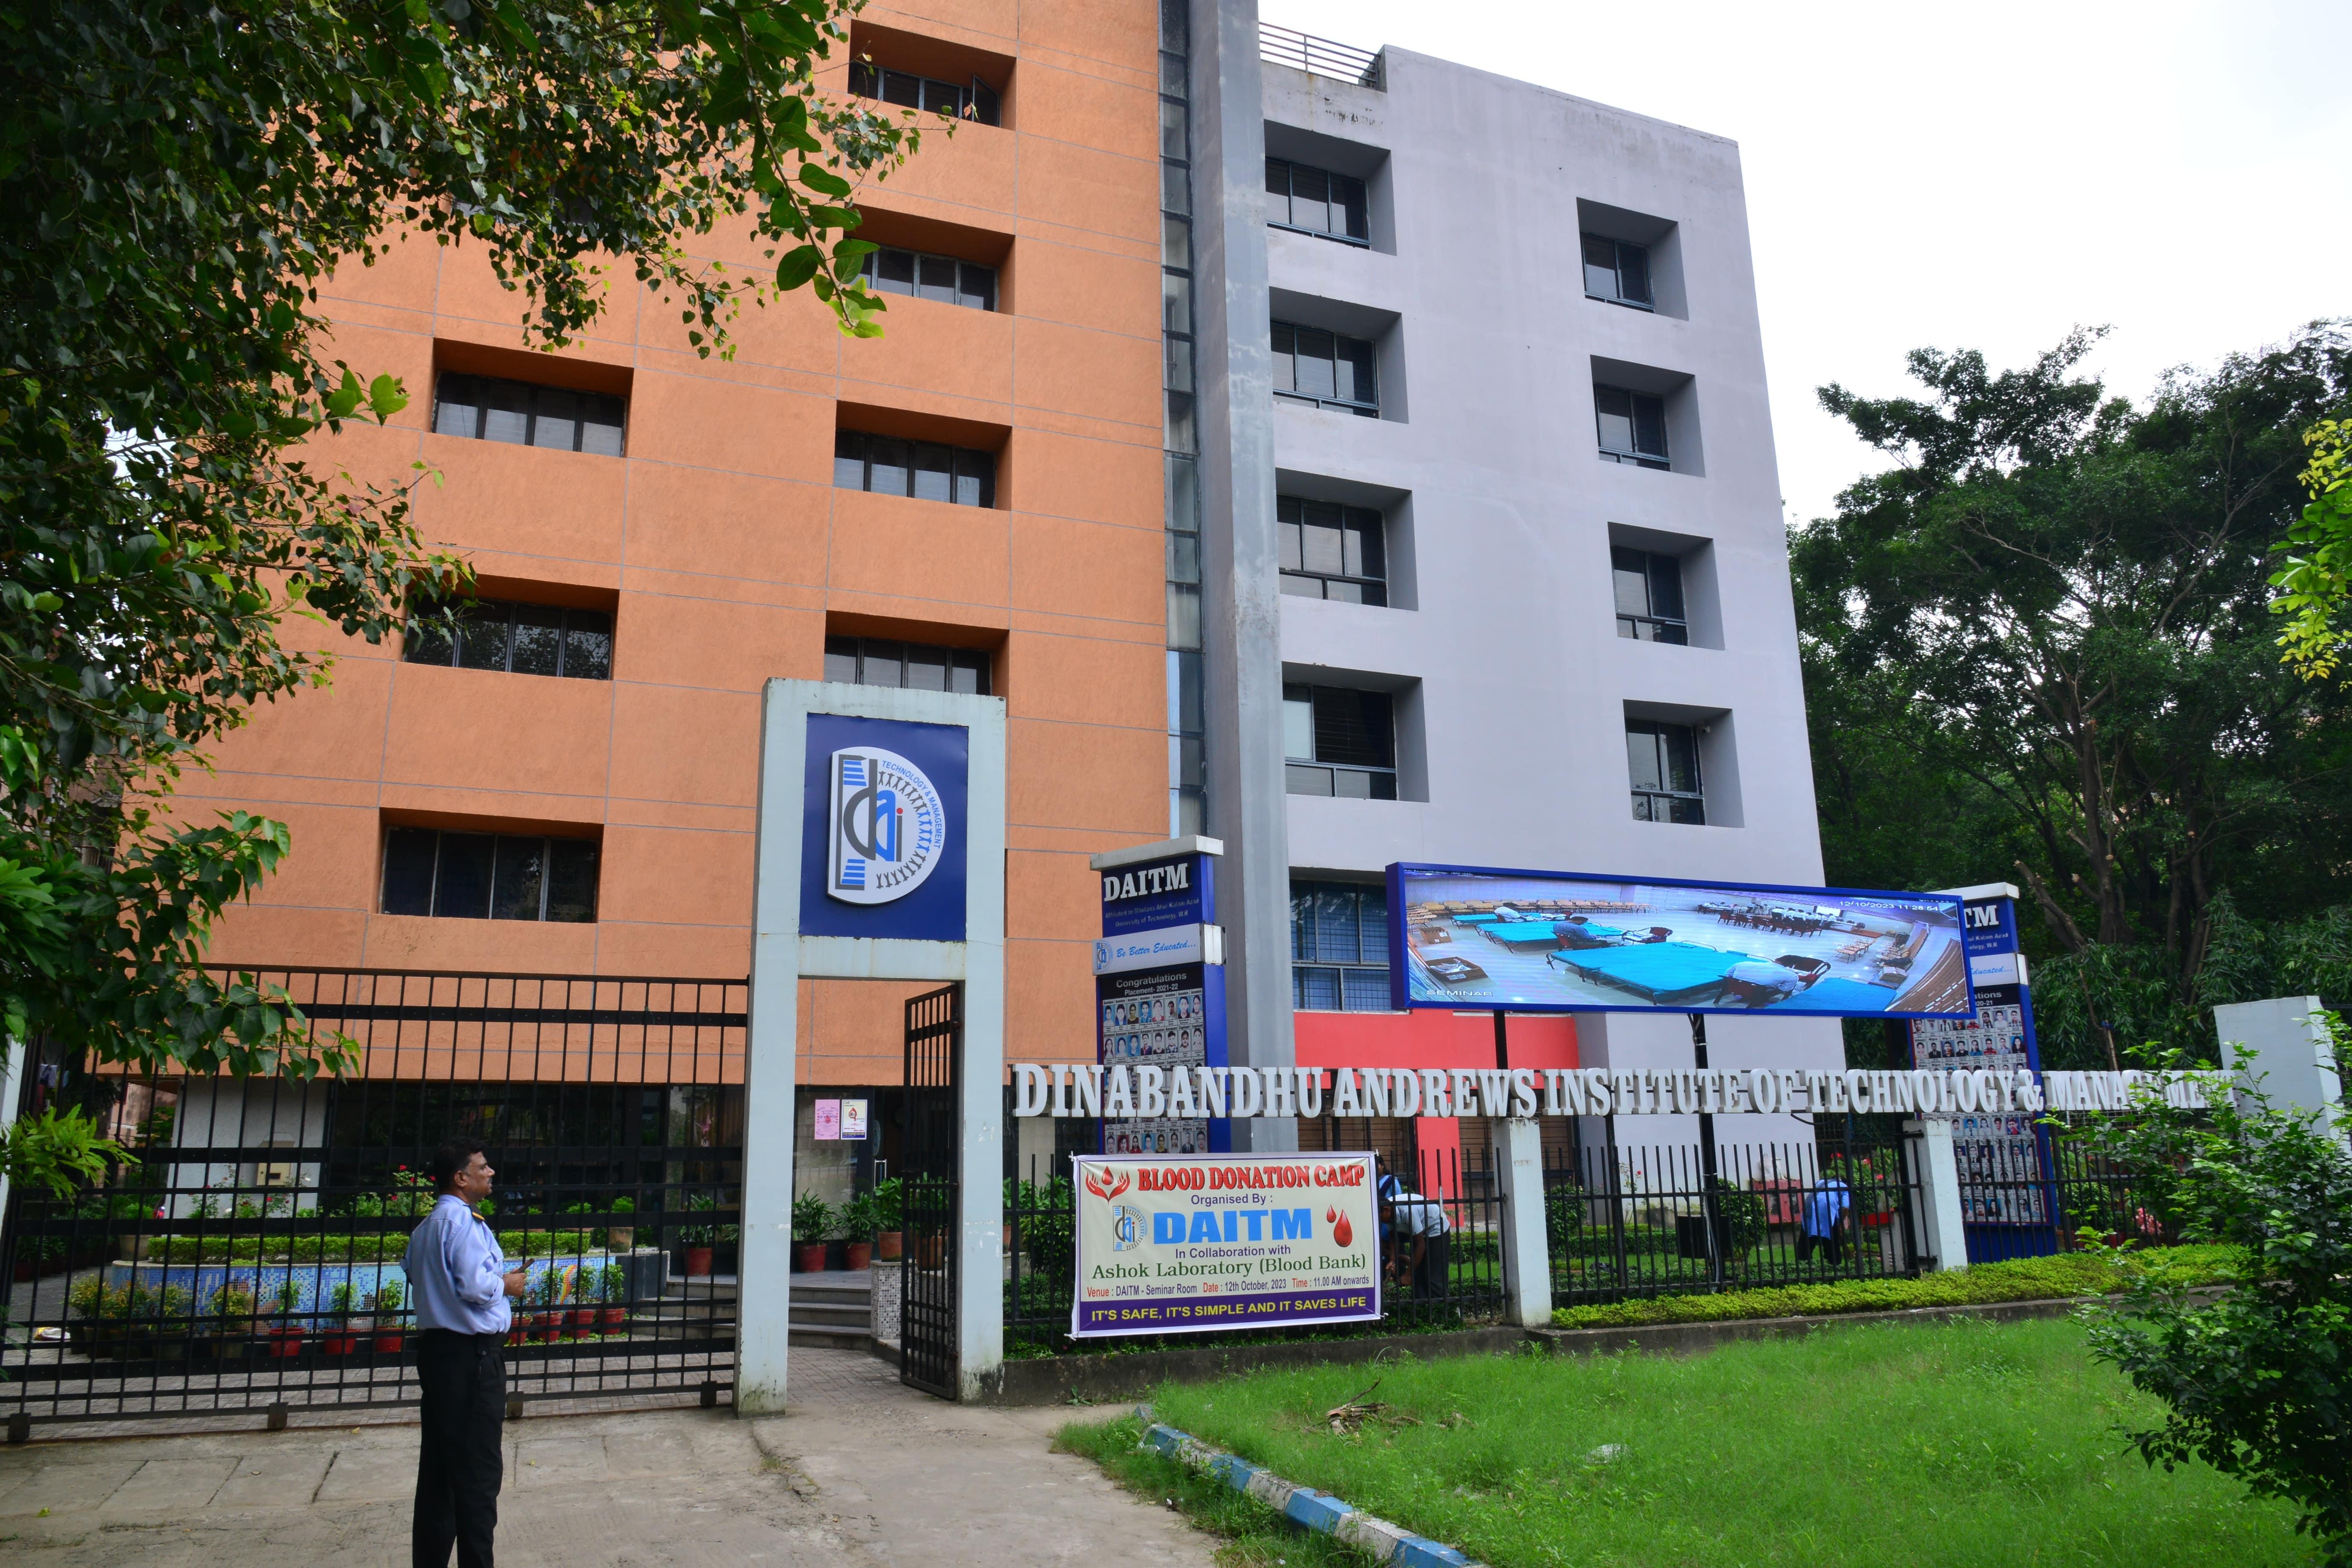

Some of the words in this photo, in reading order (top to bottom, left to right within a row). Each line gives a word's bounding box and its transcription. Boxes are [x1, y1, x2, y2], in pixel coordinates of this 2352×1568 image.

[882, 761, 928, 790] TECHNOLOGY
[928, 796, 942, 849] MANAGEMENT
[1104, 863, 1188, 902] DAITM
[1116, 948, 1126, 957] Be
[1129, 946, 1150, 956] Better
[1153, 940, 1196, 953] Educated...
[1116, 973, 1187, 988] Congratulations
[1156, 983, 1178, 992] 2021-22
[1013, 1064, 1323, 1117] DINABANDHU
[1331, 1066, 1537, 1118] ANDREWS
[1540, 1067, 1744, 1116] INSTITUTE
[1747, 1068, 1796, 1114] OF
[1799, 1069, 2015, 1113] TECHNOLOGY
[2016, 1069, 2044, 1112] &
[1138, 1167, 1205, 1191] BLOOD
[1209, 1166, 1309, 1190] DONATION
[1314, 1165, 1364, 1187] CAMP
[1191, 1194, 1248, 1207] Organised
[1253, 1193, 1266, 1205] By
[1153, 1208, 1312, 1244] DAITM
[1176, 1248, 1185, 1258] In
[1190, 1246, 1265, 1258] Collaboration
[1268, 1245, 1291, 1255] with
[1092, 1263, 1150, 1279] Ashok
[1156, 1261, 1253, 1277] Laboratory
[1260, 1256, 1312, 1274] (Blood
[1319, 1254, 1365, 1270] Bank)
[1087, 1287, 1109, 1297] Venue
[1116, 1285, 1139, 1296] DAITM
[1146, 1284, 1174, 1295] Seminar
[1177, 1283, 1197, 1294] Room
[1203, 1282, 1219, 1292] Date
[1225, 1281, 1239, 1291] 12th
[1241, 1280, 1269, 1291] October,
[1271, 1279, 1286, 1289] 2023
[1292, 1278, 1308, 1288] Time
[1314, 1277, 1329, 1287] 11.00
[1331, 1276, 1341, 1286] AM
[1343, 1275, 1369, 1285] onwards
[1092, 1310, 1117, 1321] IT'S
[1121, 1308, 1162, 1320] SAFE,
[1167, 1306, 1190, 1317] IT'S
[1195, 1304, 1244, 1316] SIMPLE
[1248, 1302, 1276, 1313] AND
[1280, 1301, 1291, 1311] IT
[1295, 1298, 1336, 1310] SAVES
[1340, 1297, 1366, 1307] LIFE
